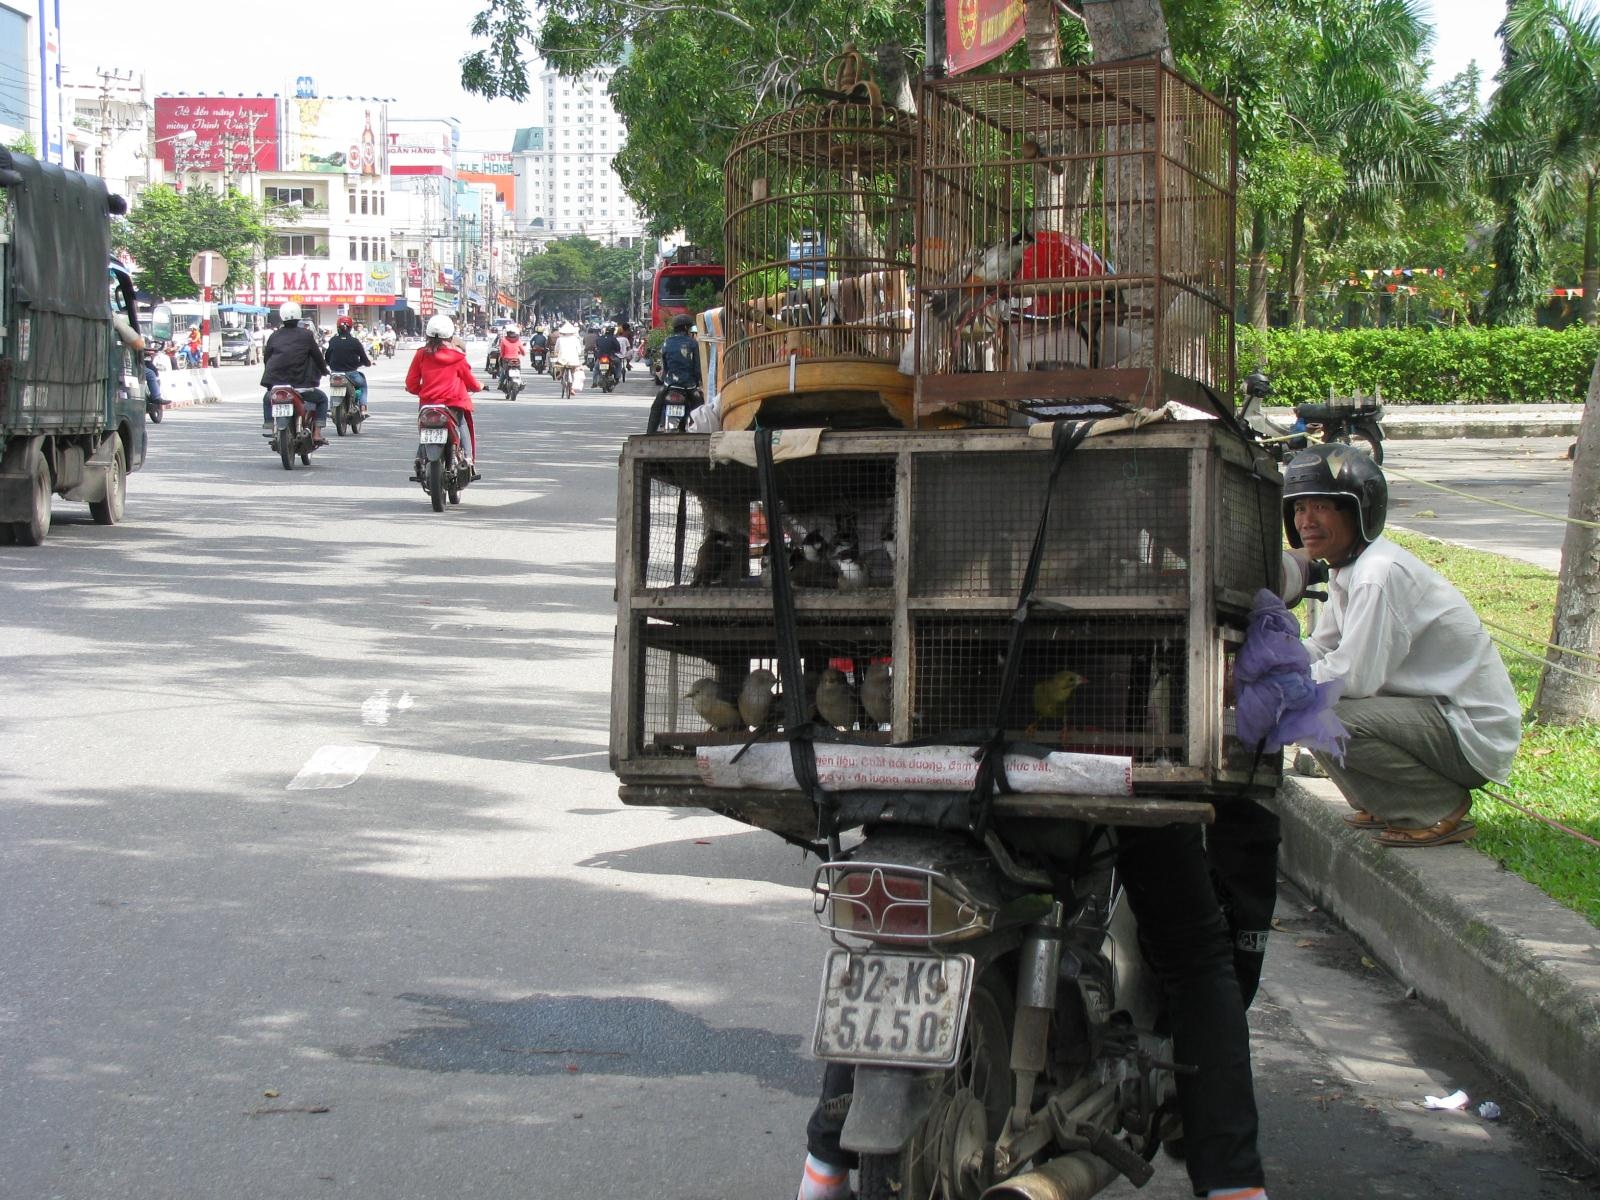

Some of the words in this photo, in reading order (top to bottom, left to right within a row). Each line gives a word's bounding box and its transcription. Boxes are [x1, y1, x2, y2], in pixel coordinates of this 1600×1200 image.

[483, 162, 514, 173] HOME
[283, 263, 321, 291] MẮT
[327, 266, 363, 291] KÍNH
[844, 957, 945, 1004] 92-K9
[837, 1006, 938, 1052] 5450
